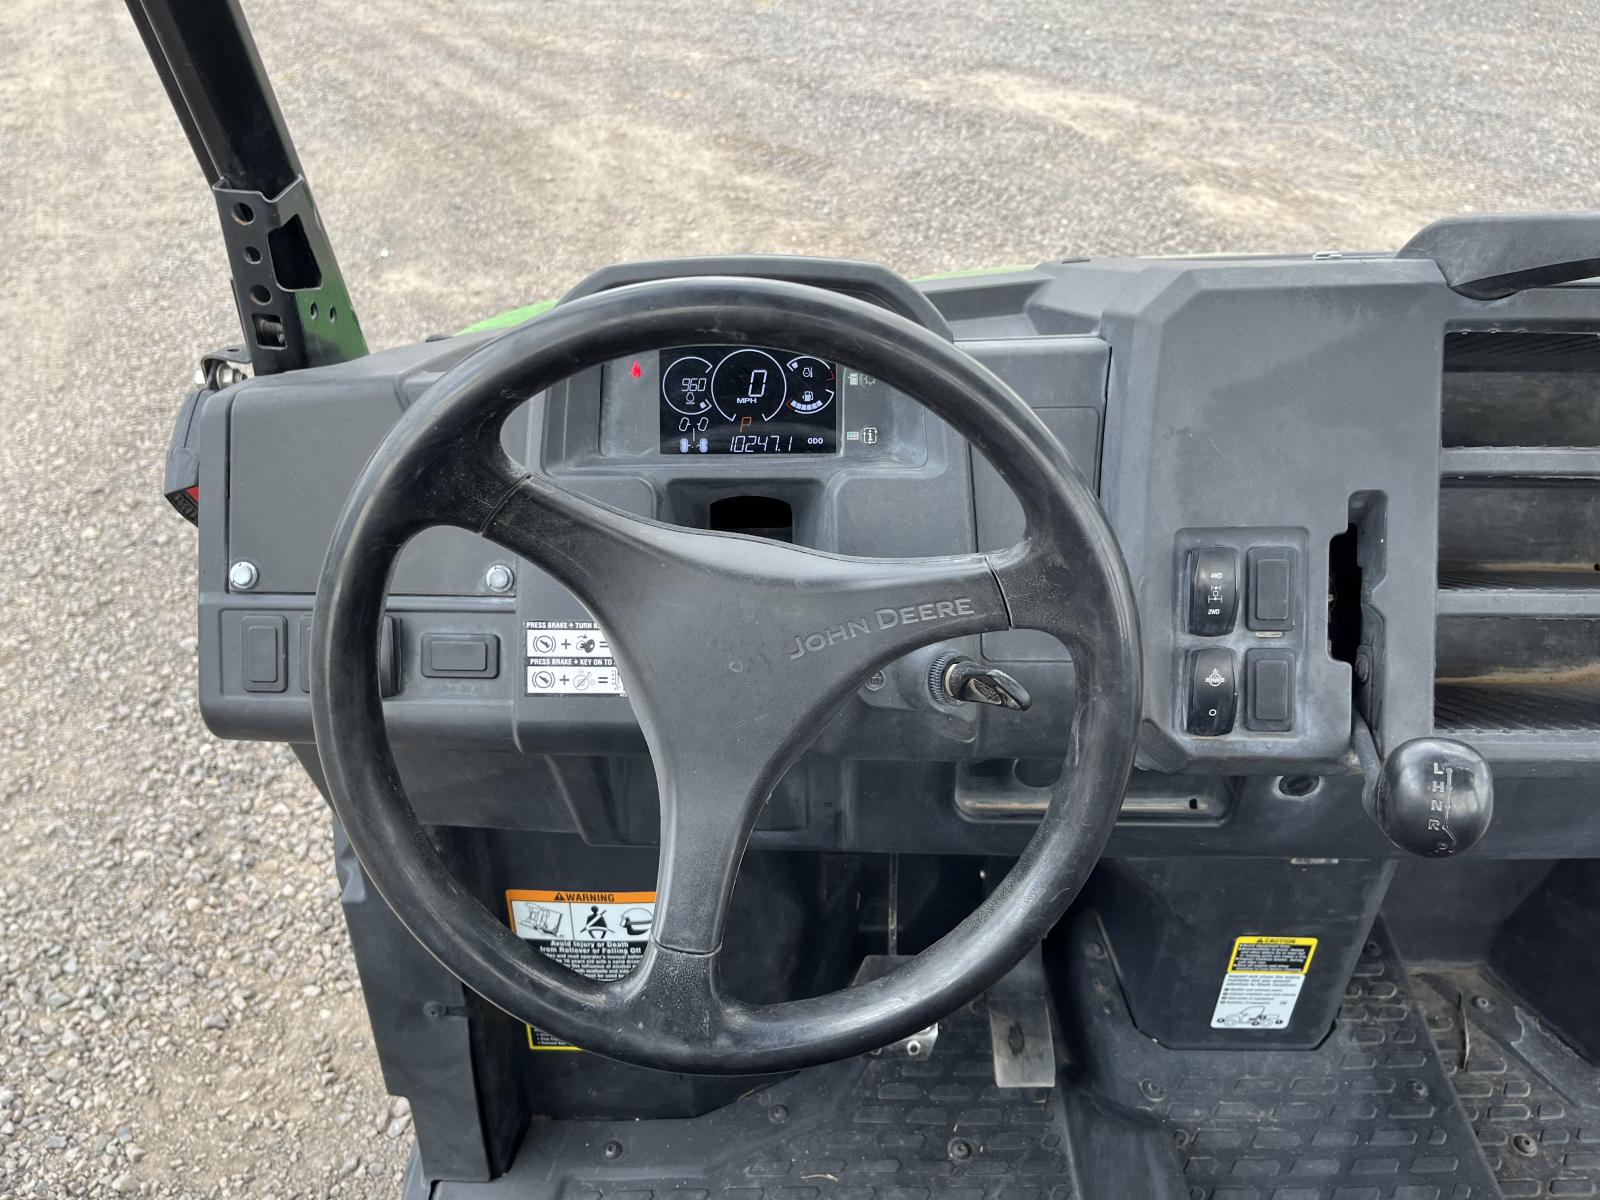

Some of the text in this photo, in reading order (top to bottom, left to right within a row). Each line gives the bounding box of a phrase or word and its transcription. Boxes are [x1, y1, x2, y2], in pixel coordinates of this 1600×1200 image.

[681, 377, 707, 392] 960
[748, 369, 767, 397] 0
[740, 416, 752, 432] P
[730, 435, 793, 453] 10247.1
[807, 437, 824, 445] ODO
[526, 621, 547, 629] PRESS
[547, 621, 568, 629] BRAKE
[789, 597, 975, 661] JOHN DEERE
[530, 658, 551, 666] PRESS
[551, 658, 573, 666] BRAKE
[580, 658, 592, 666] KEY
[593, 658, 603, 666] ON
[604, 658, 613, 666] TO
[1433, 762, 1444, 775] L
[1431, 780, 1445, 793] H
[1430, 799, 1443, 812] N
[1427, 818, 1440, 831] R
[566, 893, 615, 902] WARNING
[559, 946, 592, 954] Rollover
[602, 947, 629, 955] Falling
[630, 946, 642, 954] Off
[573, 940, 594, 949] Injury
